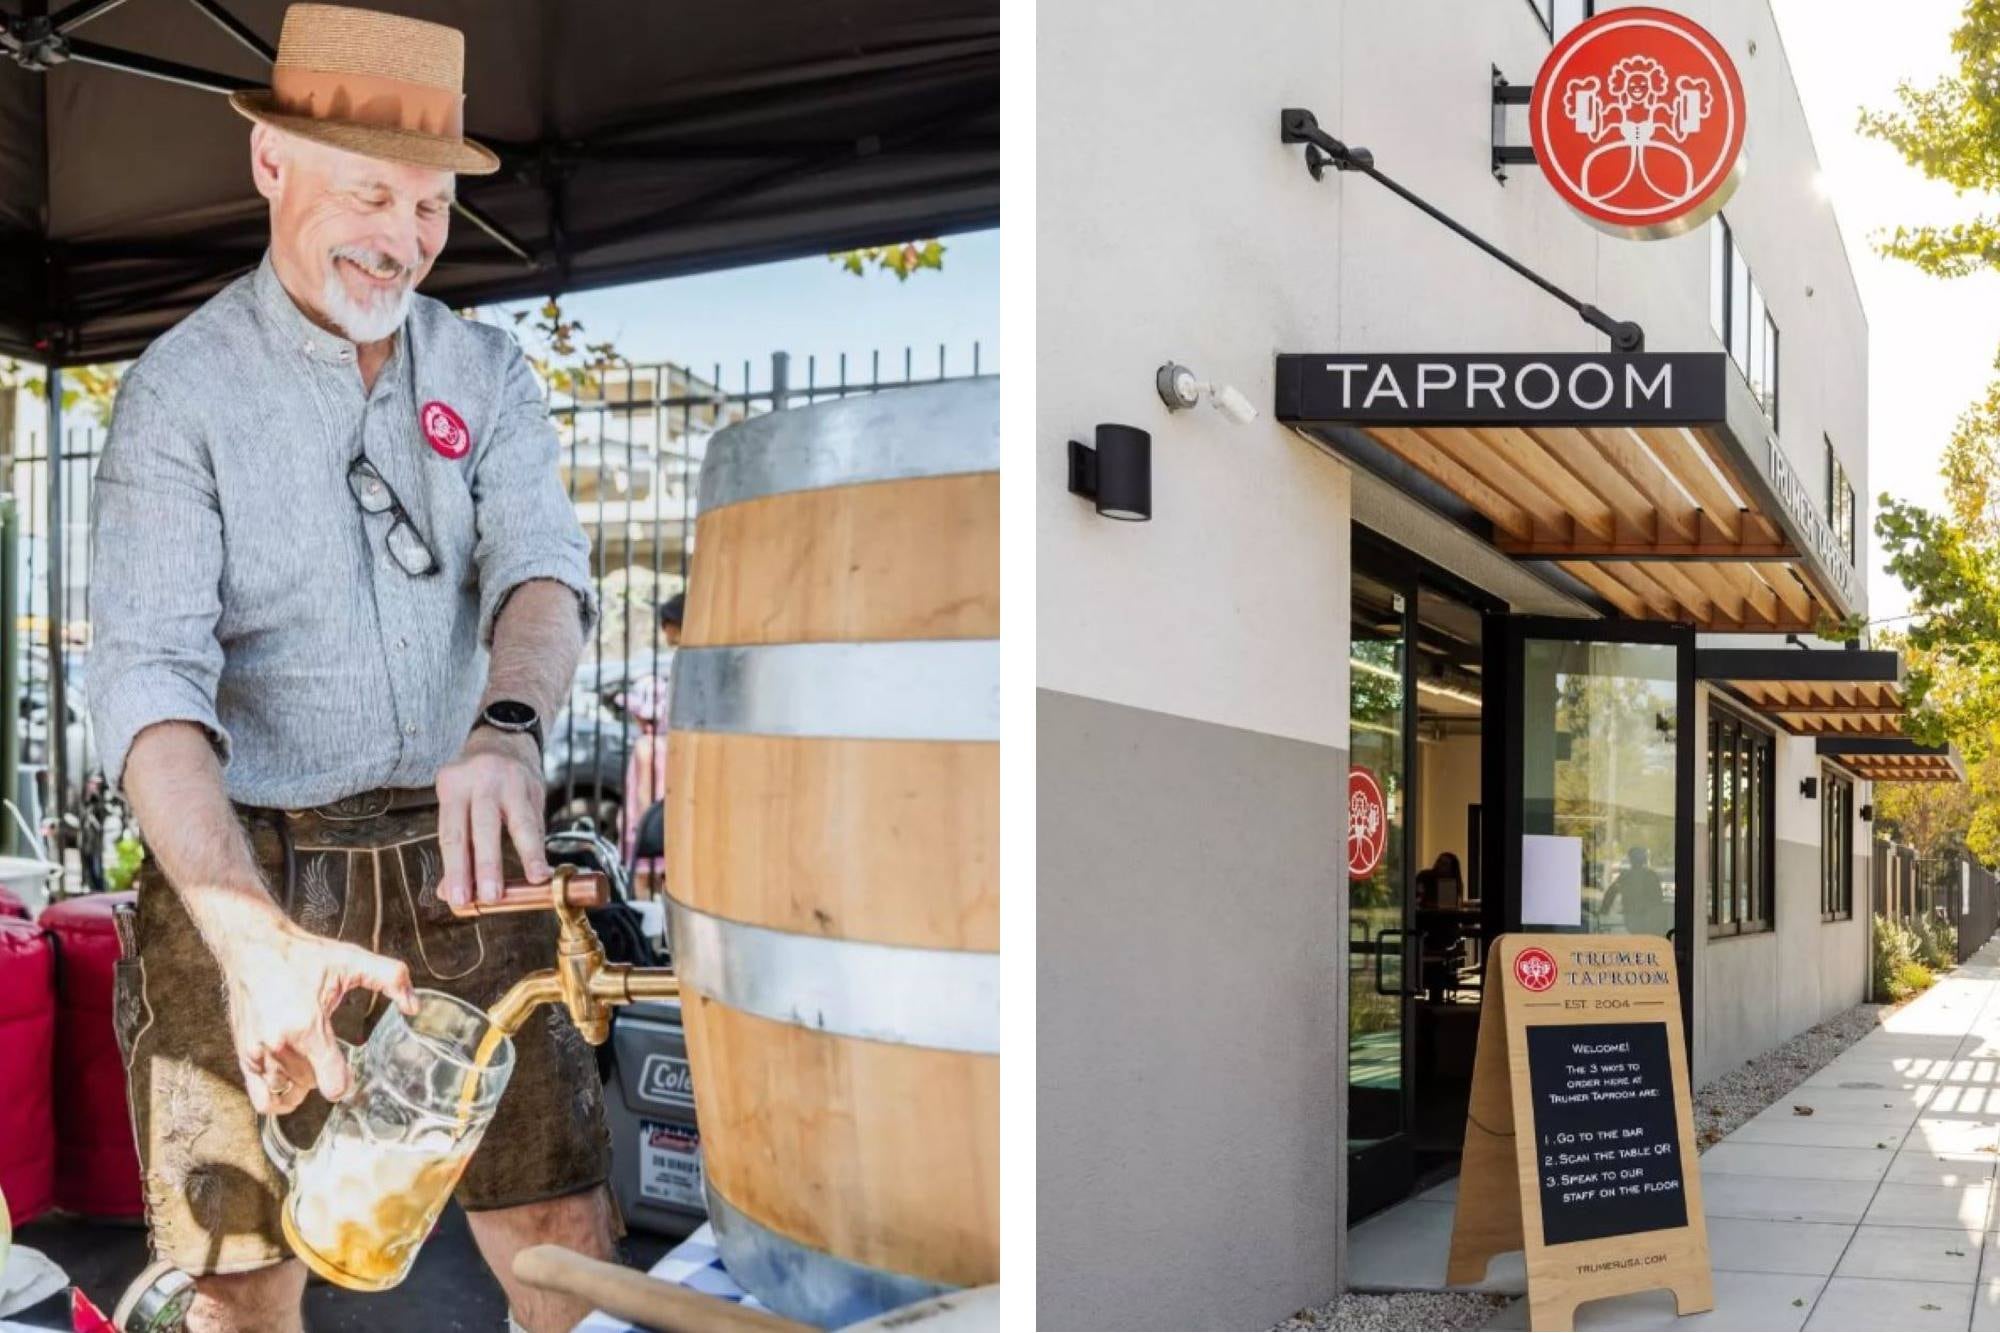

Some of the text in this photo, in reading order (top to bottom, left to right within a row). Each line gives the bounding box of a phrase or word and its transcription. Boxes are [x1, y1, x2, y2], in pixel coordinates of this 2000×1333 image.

[1326, 363, 1673, 410] TAPROOM
[1571, 951, 1659, 967] TRUMER
[1566, 971, 1669, 986] TAPROOM
[1595, 999, 1631, 1009] 2004
[1572, 1042, 1630, 1054] WELCOME!
[1566, 1065, 1586, 1074] THE
[1590, 1064, 1598, 1073] 3
[1628, 1063, 1640, 1071] TO
[1567, 1075, 1642, 1088] ORDER HERE AT
[1549, 1093, 1589, 1103] TRUMER
[1591, 1090, 1635, 1101] TAPROOM
[1578, 1132, 1593, 1142] TO
[1598, 1130, 1619, 1140] THE
[1622, 1127, 1643, 1137] BAR
[1559, 1153, 1590, 1165] SCAN
[1594, 1151, 1615, 1161] THE
[1619, 1147, 1651, 1158] TABLE
[1654, 1143, 1671, 1154] OR
[1562, 1173, 1598, 1186] SPEAK
[1601, 1171, 1616, 1181] TO
[1620, 1167, 1643, 1178] OUR
[1563, 1180, 1679, 1203] STAFF ON THE FLOOR
[1576, 1254, 1668, 1275] TRUMERUSA.COM
